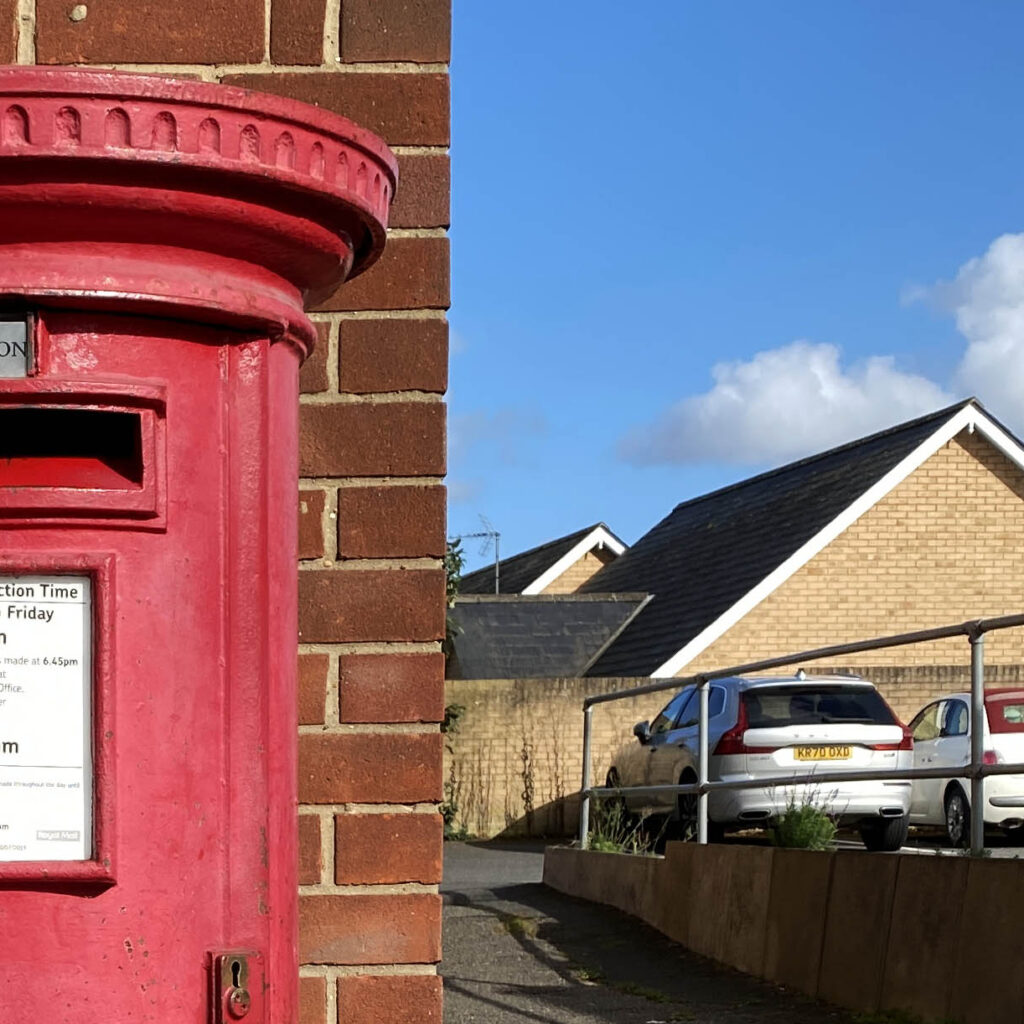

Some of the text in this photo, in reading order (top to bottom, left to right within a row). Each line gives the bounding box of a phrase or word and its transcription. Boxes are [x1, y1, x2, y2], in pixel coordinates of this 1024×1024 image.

[40, 584, 78, 599] Time
[7, 606, 55, 622] Friday
[4, 656, 29, 665] made
[31, 656, 40, 666] at
[43, 656, 78, 668] 6.45pm
[797, 746, 826, 758] KR70
